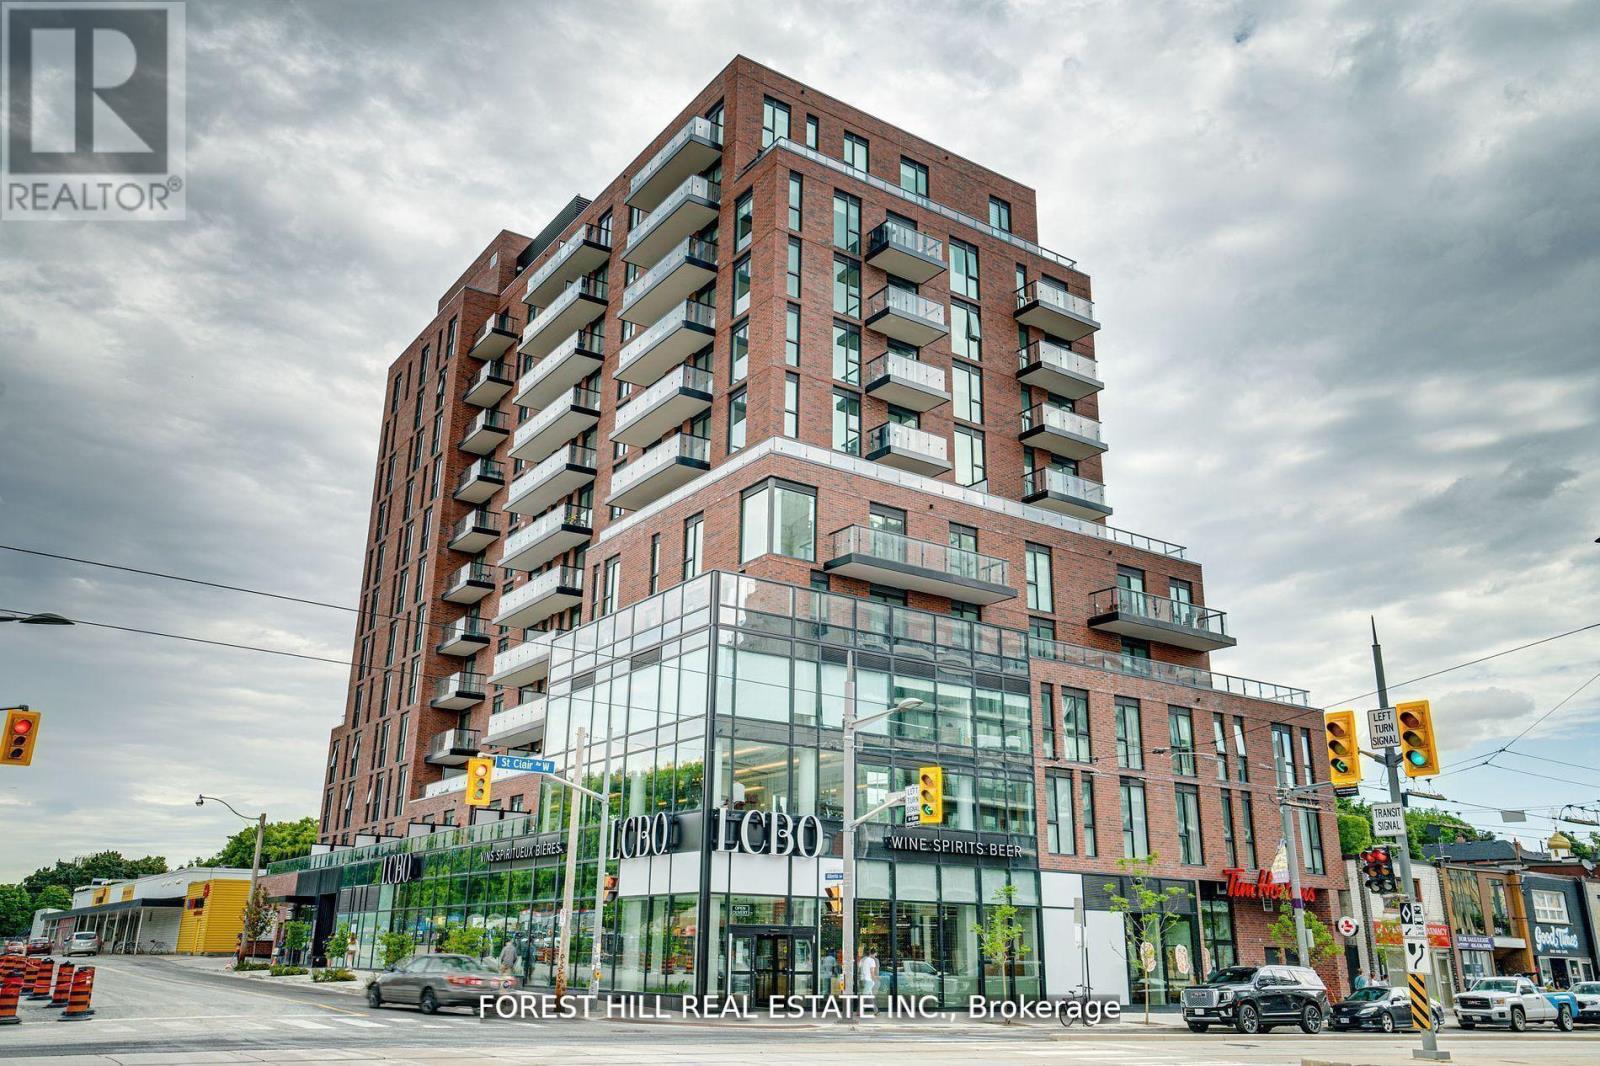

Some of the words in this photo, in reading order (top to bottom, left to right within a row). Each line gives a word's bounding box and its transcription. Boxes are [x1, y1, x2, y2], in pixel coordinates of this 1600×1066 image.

[1373, 711, 1391, 721] LEFT
[1374, 724, 1394, 734] TURN
[1372, 735, 1398, 746] SIGNAL
[501, 757, 510, 767] St
[513, 759, 533, 770] Clair
[542, 762, 550, 771] W
[1374, 807, 1401, 818] TRANSIT
[717, 808, 824, 858] LCBO
[1377, 821, 1401, 831] SIGNAL
[610, 811, 667, 860] LCBO
[891, 836, 927, 851] WINE
[933, 839, 984, 855] SPIRITS
[989, 843, 1022, 857] BEER
[381, 853, 411, 884] LCBO
[1535, 926, 1558, 952] Good
